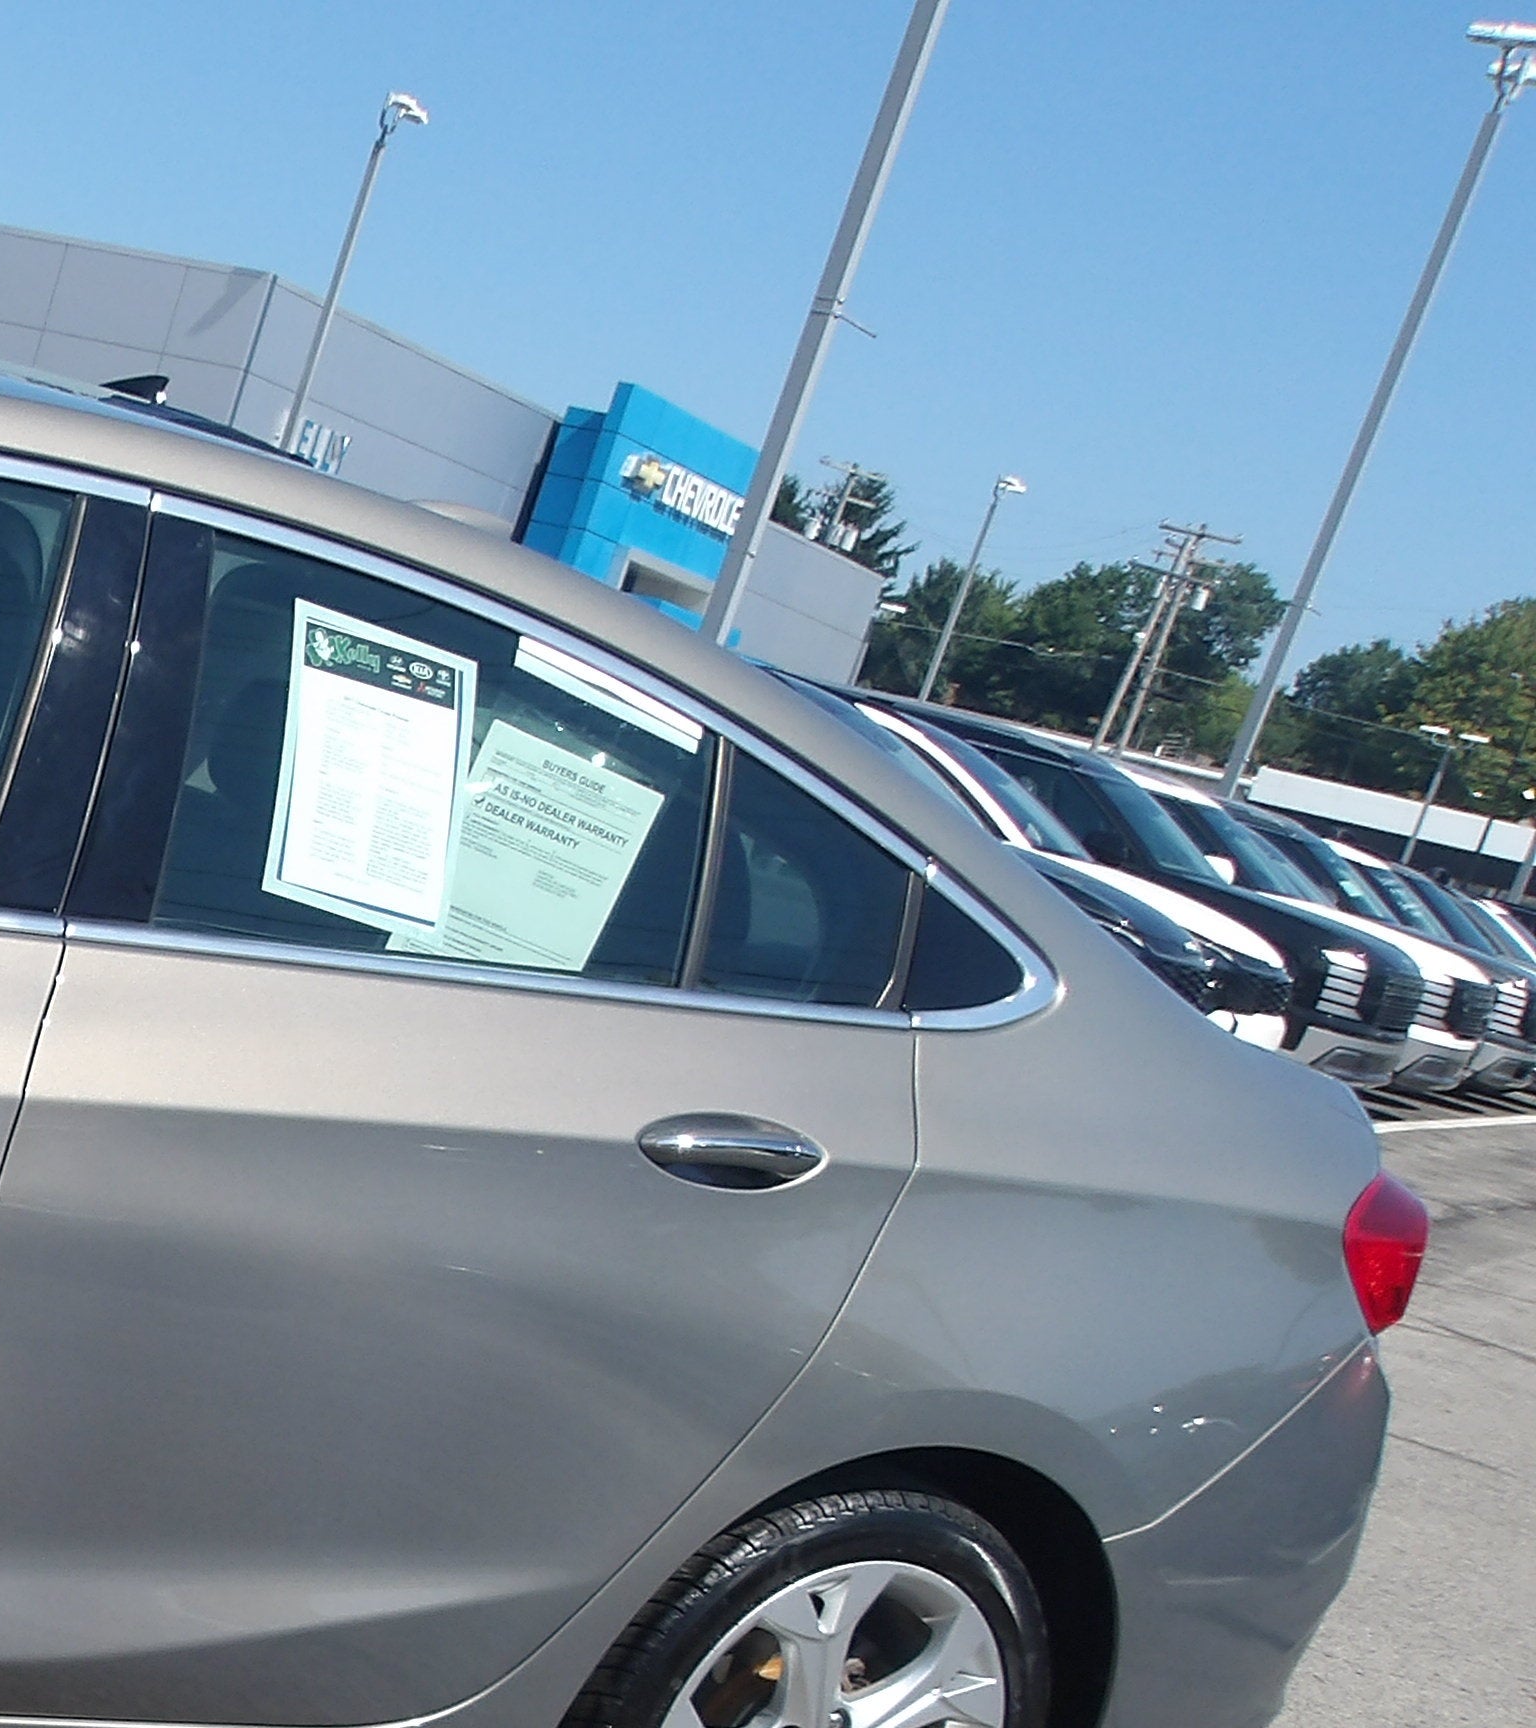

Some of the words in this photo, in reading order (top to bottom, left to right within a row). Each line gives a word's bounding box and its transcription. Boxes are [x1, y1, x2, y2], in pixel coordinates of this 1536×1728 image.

[661, 465, 746, 536] CHEVROLE
[411, 662, 432, 679] KIA
[542, 759, 578, 783] BUYERS
[579, 775, 606, 794] GUIDE
[485, 801, 525, 826] DEALER
[525, 818, 580, 850] WARRANTY
[493, 782, 509, 797] AS
[537, 801, 577, 826] DEALER
[577, 819, 630, 848] WARRANTY
